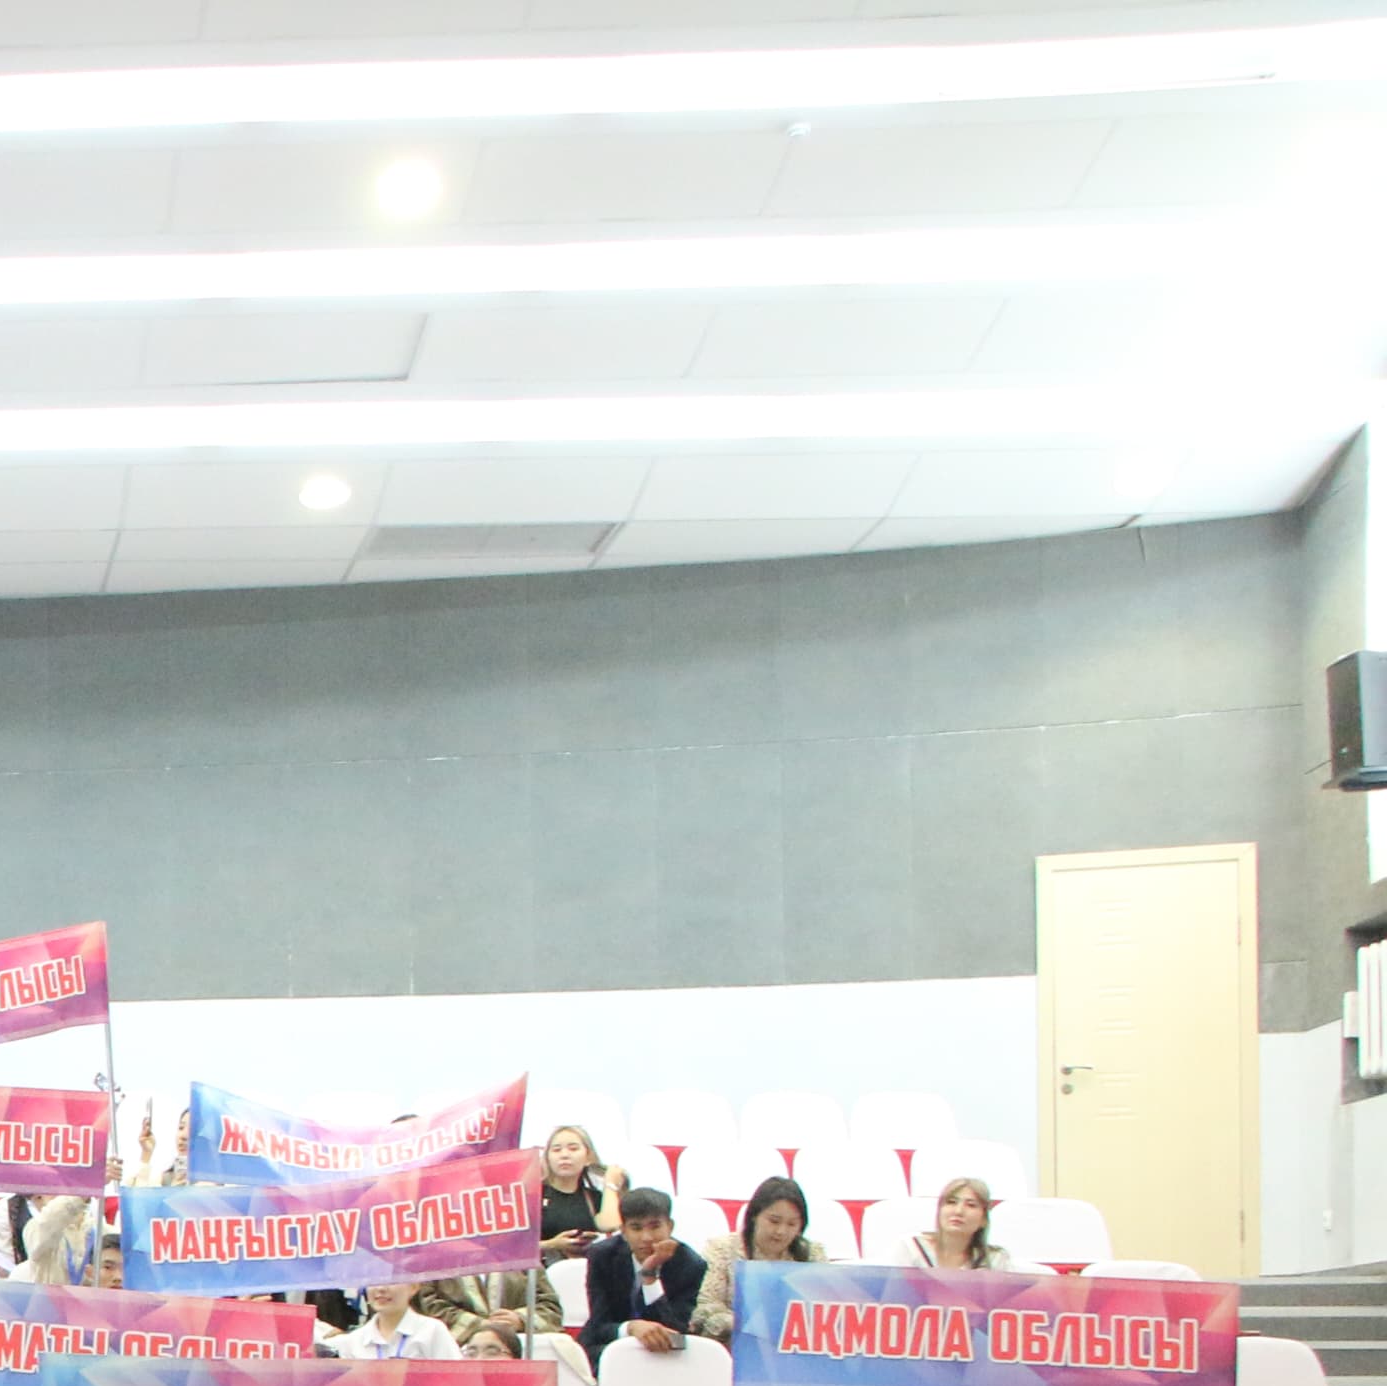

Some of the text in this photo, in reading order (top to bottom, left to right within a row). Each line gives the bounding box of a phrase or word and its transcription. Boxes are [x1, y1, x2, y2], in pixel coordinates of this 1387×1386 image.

[219, 1103, 505, 1171] ЖАМБЫЛ ОБЛЫСЫ
[150, 1181, 530, 1264] МАҢҒЫСТАУ ОБЛЫСЫ
[779, 1300, 1199, 1373] АҚМОЛА ОБЛЫСЫ
